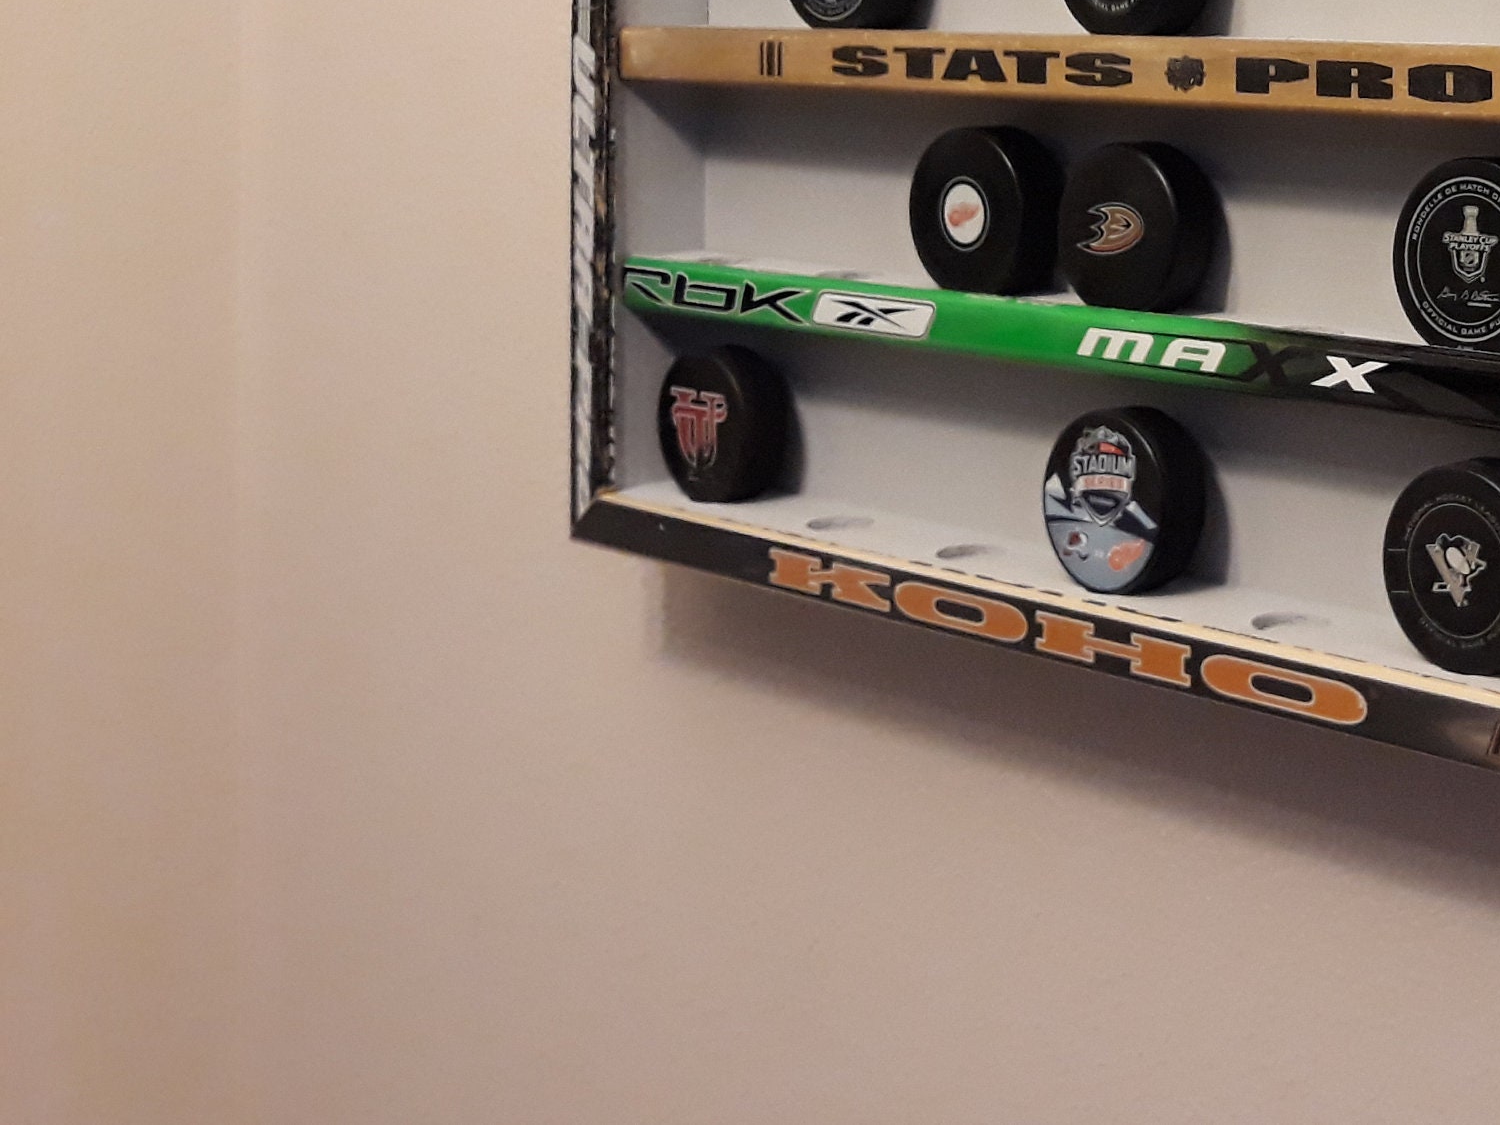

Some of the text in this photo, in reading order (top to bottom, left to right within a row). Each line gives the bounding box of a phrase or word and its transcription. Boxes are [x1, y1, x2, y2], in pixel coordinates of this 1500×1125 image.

[831, 45, 1493, 104] STATS PRO
[1444, 184, 1458, 195] DE
[1459, 183, 1491, 196] MATCH
[1443, 233, 1498, 245] STANLEY CUP
[1449, 242, 1491, 252] PLAYOFFS
[1422, 300, 1458, 334] OFFICIAL
[1460, 325, 1487, 335] GAME
[1071, 454, 1136, 478] STADIUM
[768, 546, 1368, 725] KOHO
